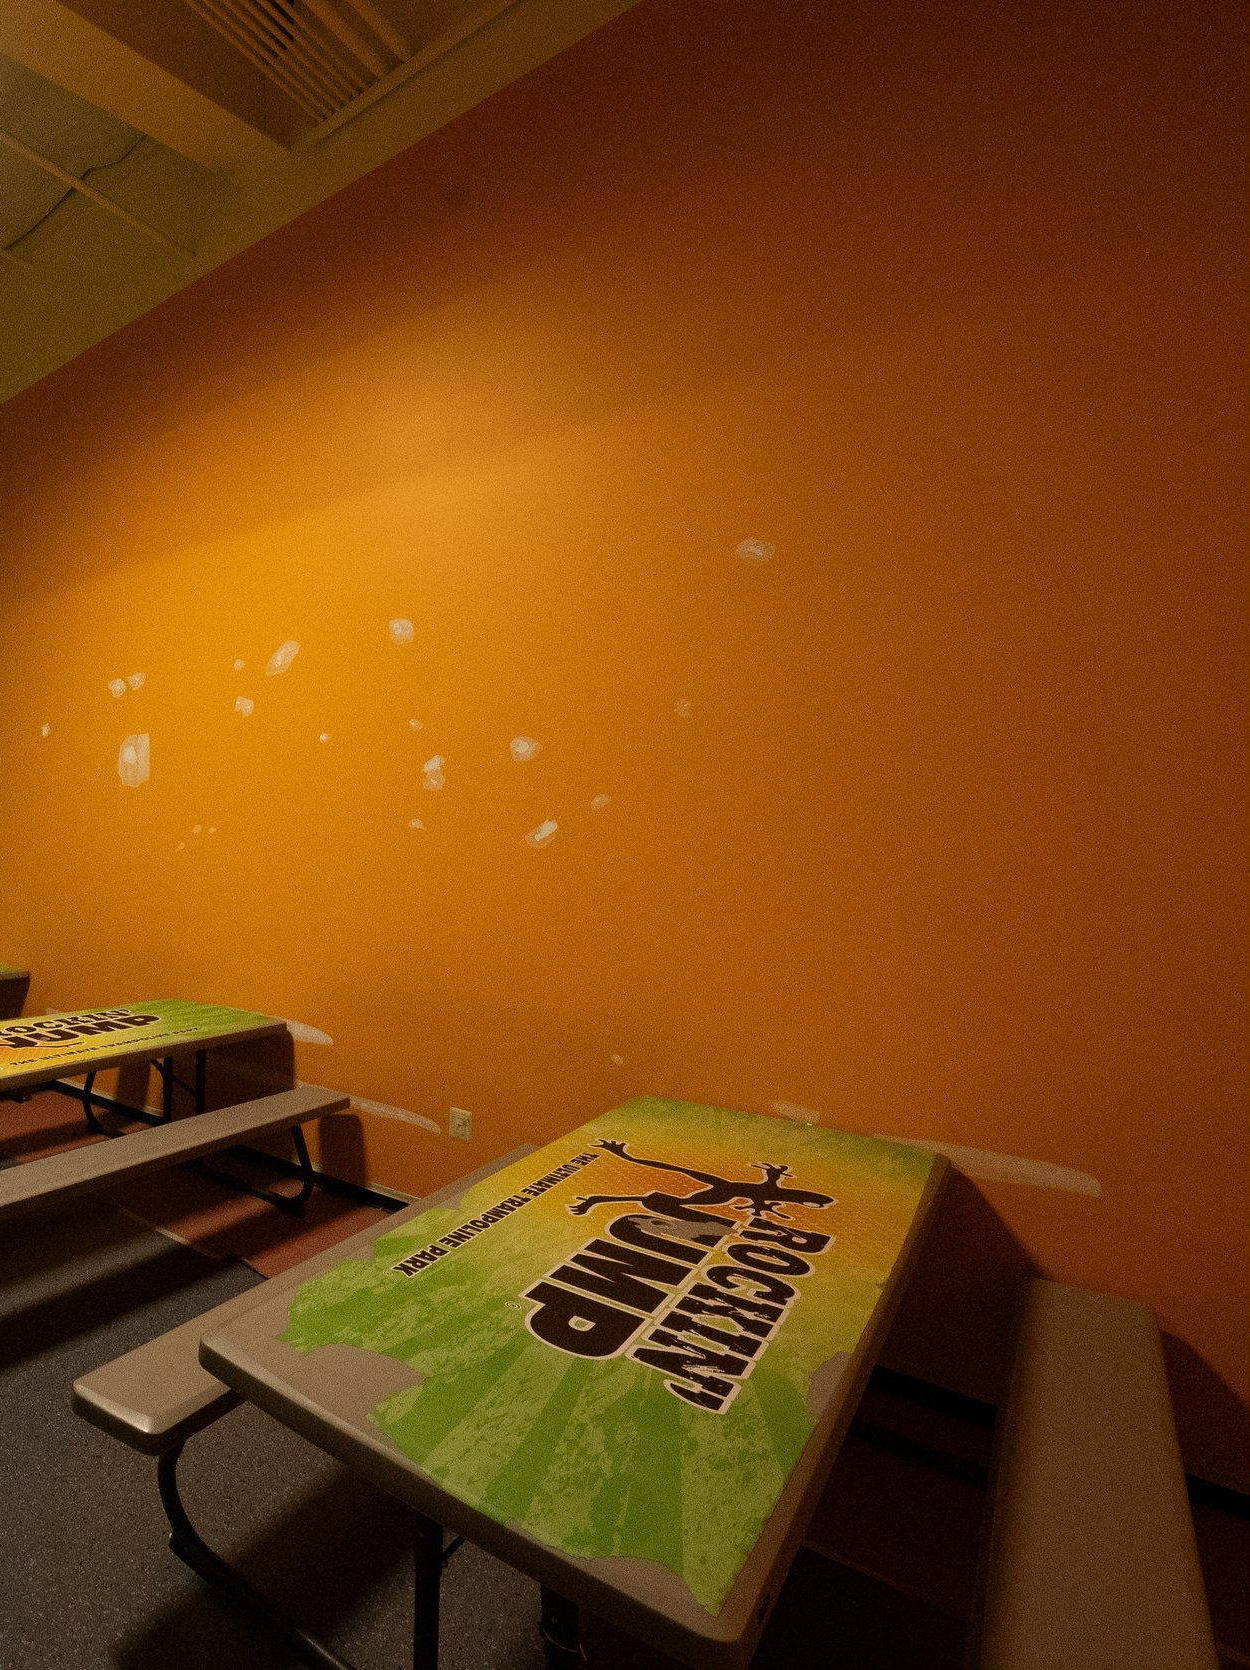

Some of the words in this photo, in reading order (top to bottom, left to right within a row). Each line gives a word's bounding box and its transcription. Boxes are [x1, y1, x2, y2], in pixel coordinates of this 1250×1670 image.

[2, 1014, 161, 1048] JUMP
[569, 1151, 600, 1167] THE
[520, 1163, 582, 1197] ULTIMATE
[438, 1194, 532, 1249] TRAMPOLINE
[391, 1244, 450, 1278] PARK
[518, 1206, 740, 1361] JUMP
[624, 1215, 837, 1415] ROCKIN'
